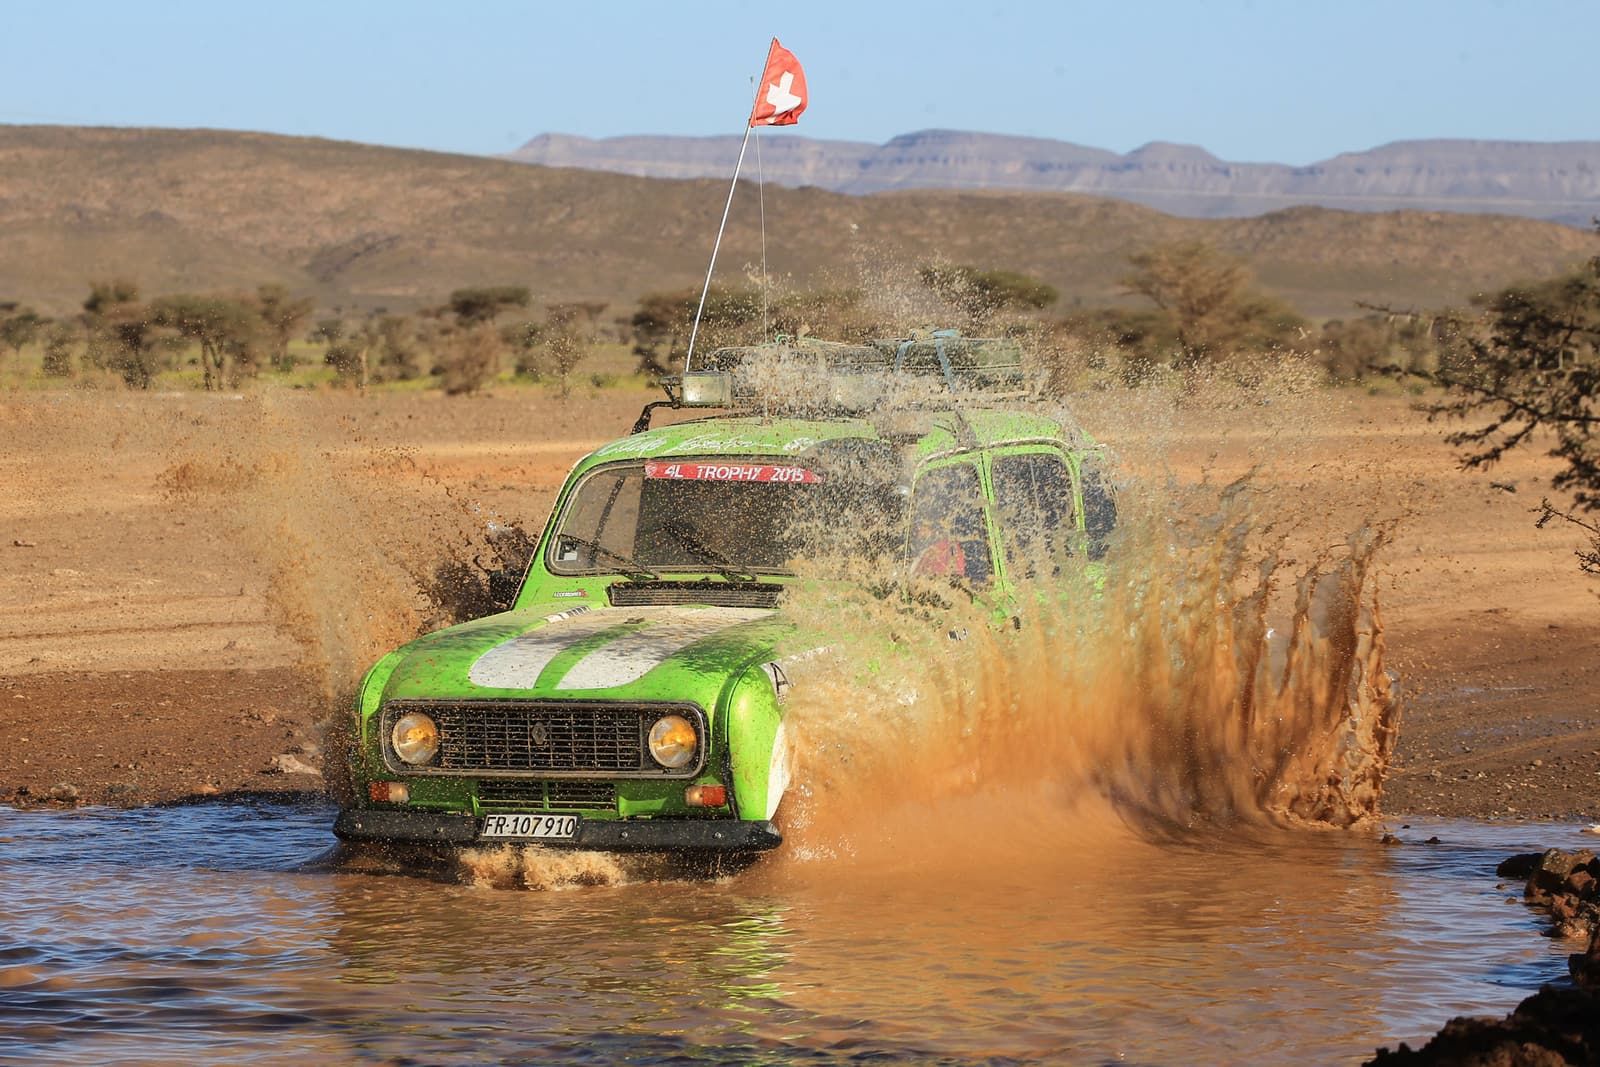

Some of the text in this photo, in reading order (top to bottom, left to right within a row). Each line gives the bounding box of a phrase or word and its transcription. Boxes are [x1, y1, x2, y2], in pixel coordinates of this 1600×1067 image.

[664, 464, 806, 482] 4L TROPHY 2015
